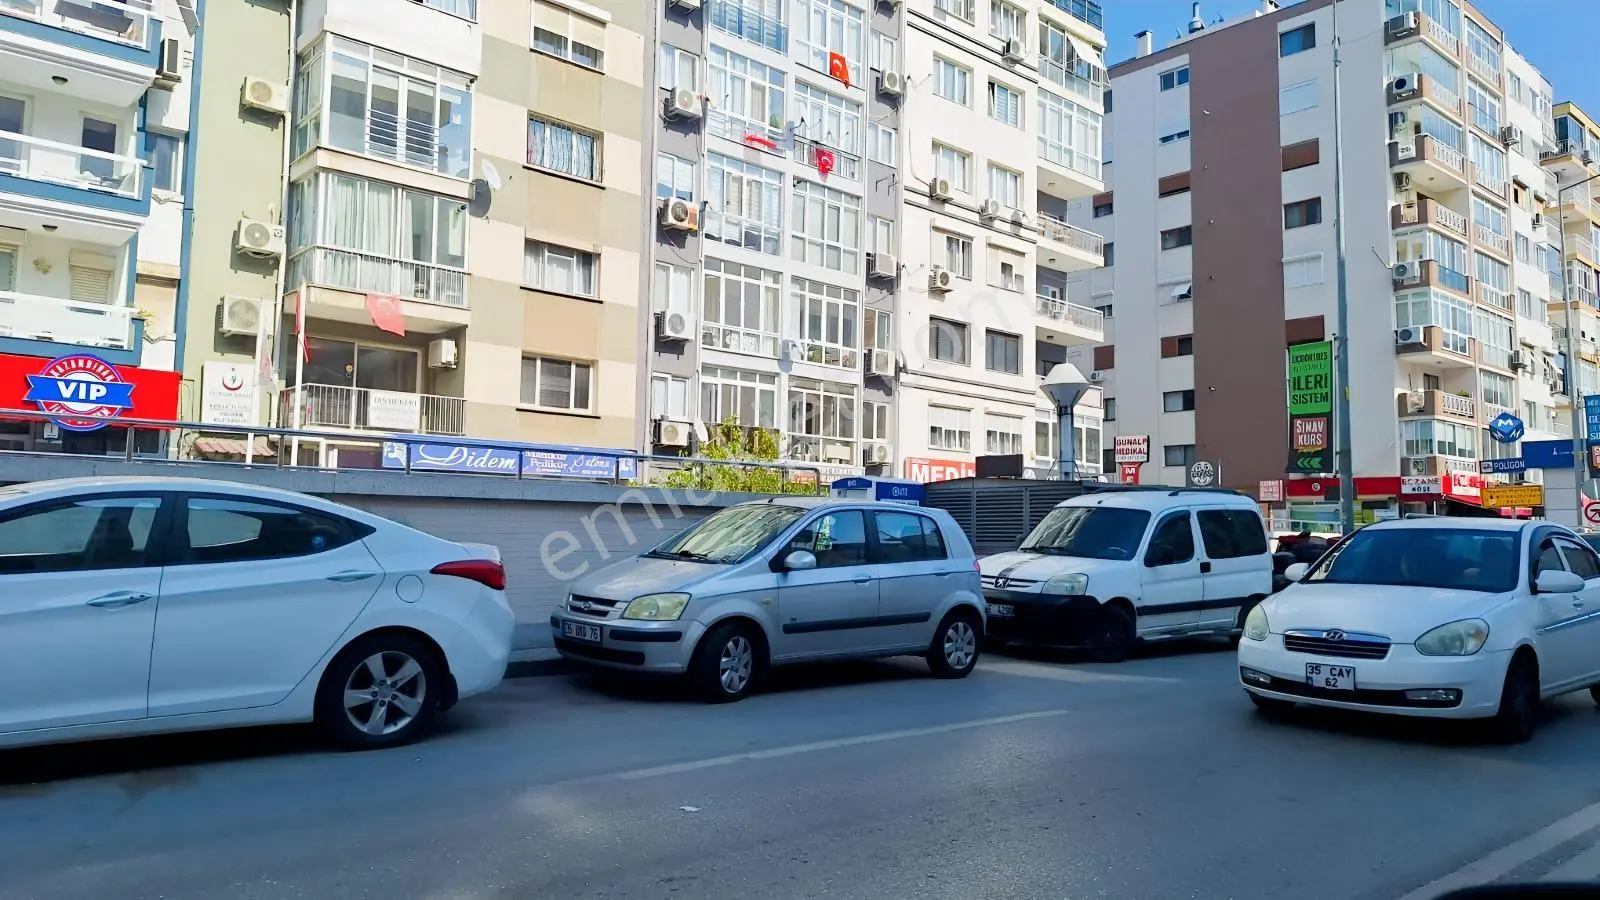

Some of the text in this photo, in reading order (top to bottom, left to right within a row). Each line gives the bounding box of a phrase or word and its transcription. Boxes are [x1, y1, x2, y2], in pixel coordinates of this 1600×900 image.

[57, 381, 107, 401] VIP
[1296, 420, 1324, 434] SINAV
[1298, 433, 1322, 446] KURS
[415, 444, 516, 470] Didem
[1402, 477, 1441, 486] ECZANE
[1308, 664, 1352, 678] 35 CAY
[1325, 676, 1339, 688] 62
